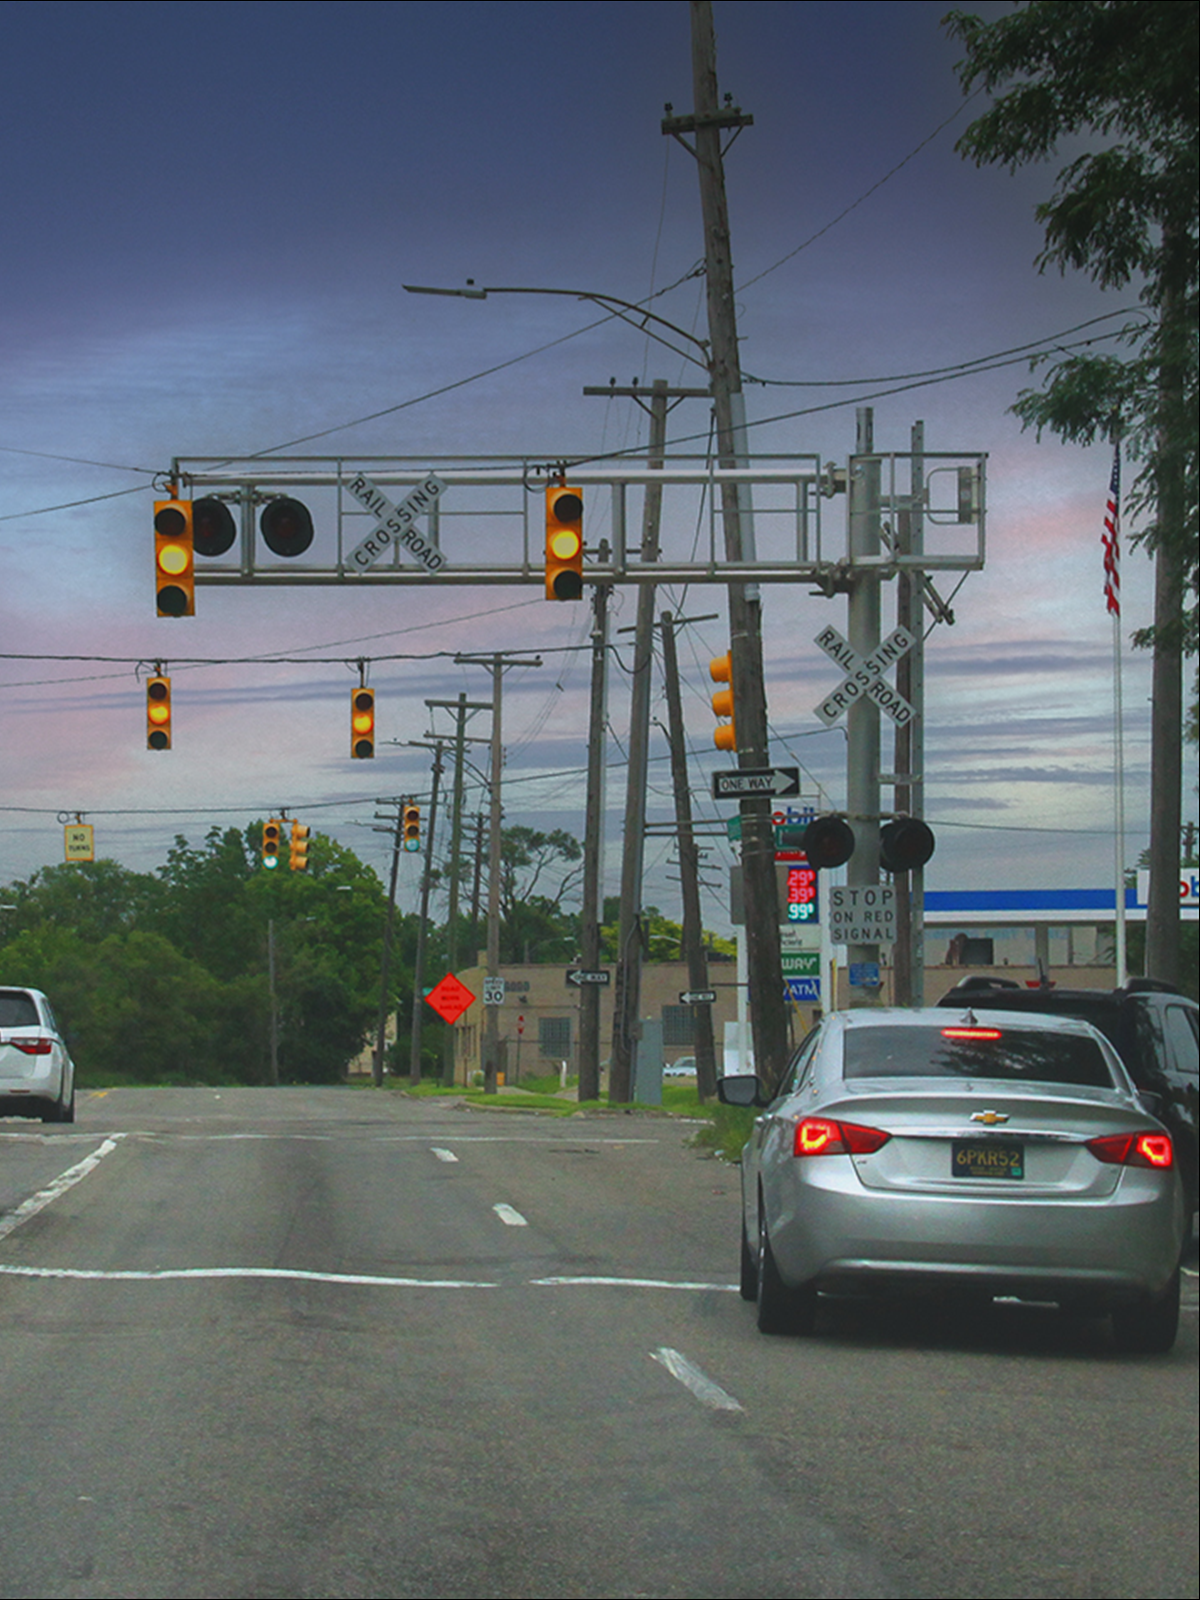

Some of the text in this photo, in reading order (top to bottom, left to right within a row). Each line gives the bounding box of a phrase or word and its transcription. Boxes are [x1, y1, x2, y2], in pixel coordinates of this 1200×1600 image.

[350, 477, 442, 570] RAIL ROAD
[354, 480, 439, 566] CROSSING
[818, 630, 911, 723] RAIL ROAD
[822, 633, 909, 718] CROSSING
[721, 776, 773, 791] ONE WAY
[771, 806, 815, 826] obil
[72, 833, 86, 842] NO
[833, 889, 894, 906] STOP
[833, 910, 894, 923] ON RED
[834, 928, 894, 940] SIGNAL
[781, 957, 817, 970] WAY
[484, 991, 503, 1002] 30
[789, 984, 817, 996] ATM
